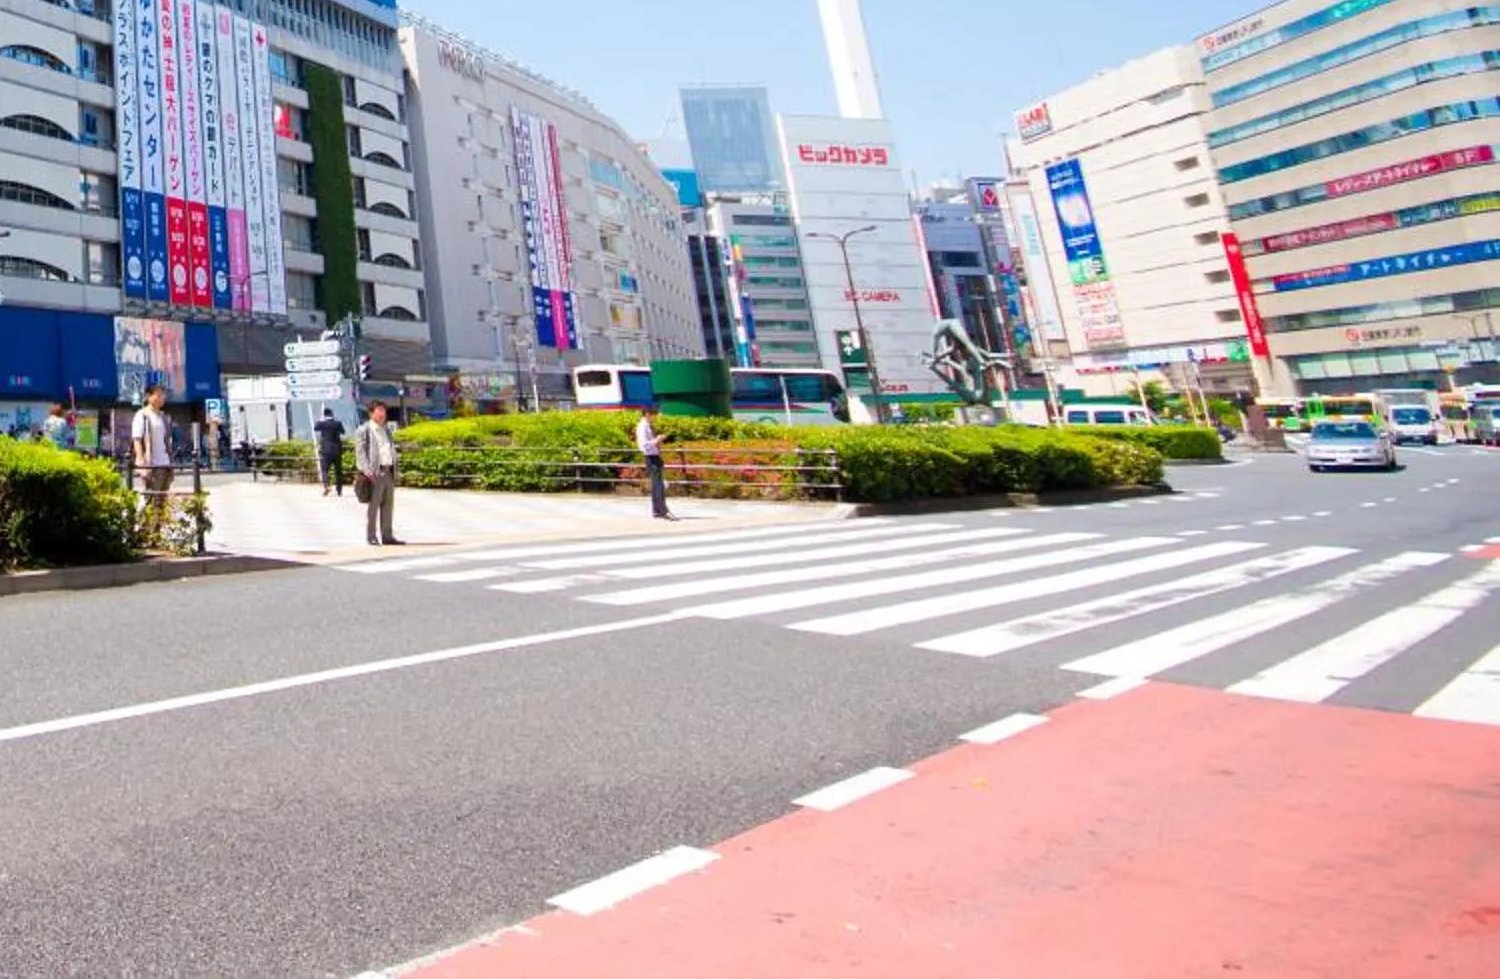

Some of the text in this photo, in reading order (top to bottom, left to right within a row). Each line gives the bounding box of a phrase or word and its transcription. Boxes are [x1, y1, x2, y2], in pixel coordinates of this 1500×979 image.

[797, 144, 889, 166] ビックカメラ
[1359, 250, 1464, 276] アートネイチャー
